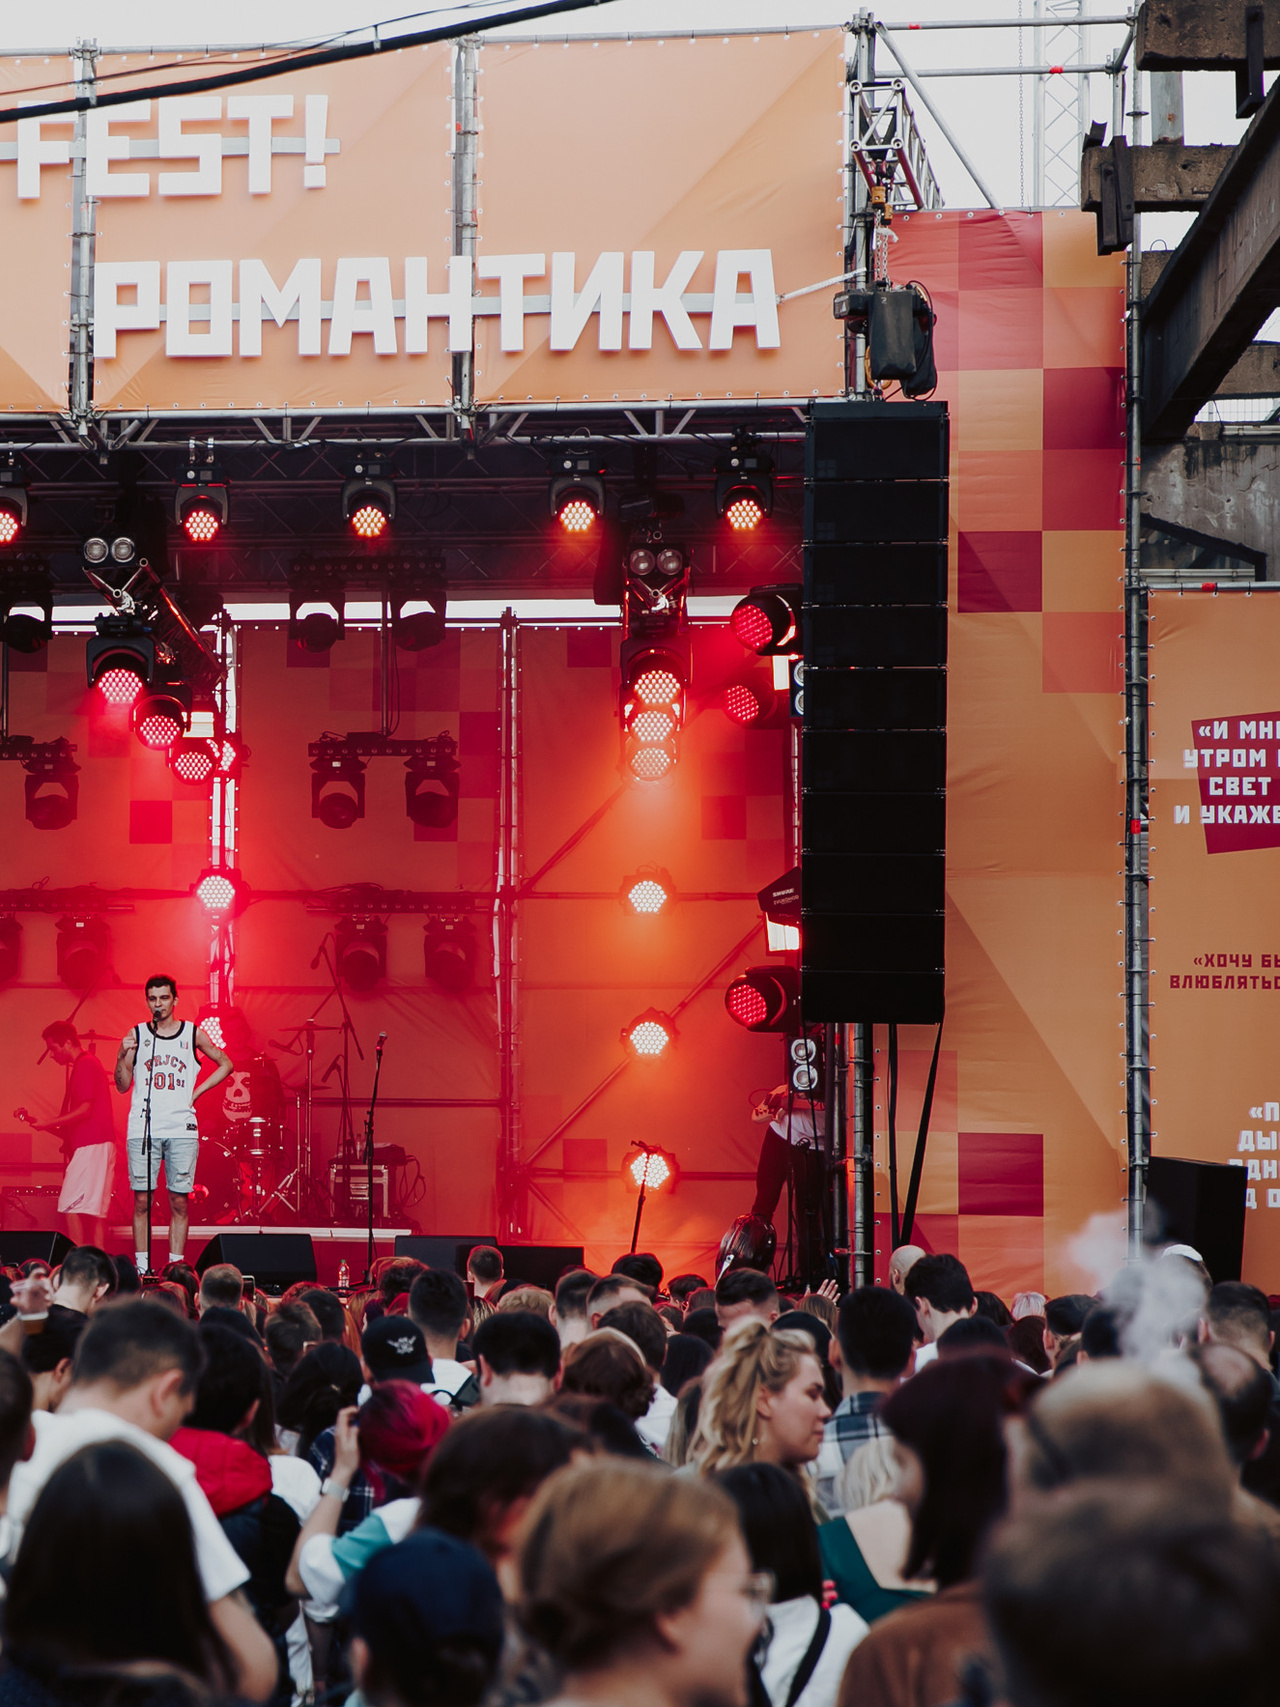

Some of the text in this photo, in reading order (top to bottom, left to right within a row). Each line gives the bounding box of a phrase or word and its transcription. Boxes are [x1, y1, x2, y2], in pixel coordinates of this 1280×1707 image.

[17, 94, 329, 199] FEST!
[93, 249, 781, 358] РОМАНТИКА
[1183, 749, 1267, 768] УТРОМ
[1208, 776, 1272, 796] СВЕТ
[1174, 805, 1190, 824] И
[1193, 953, 1252, 968] «ХОЧУ
[154, 1072, 175, 1090] 01
